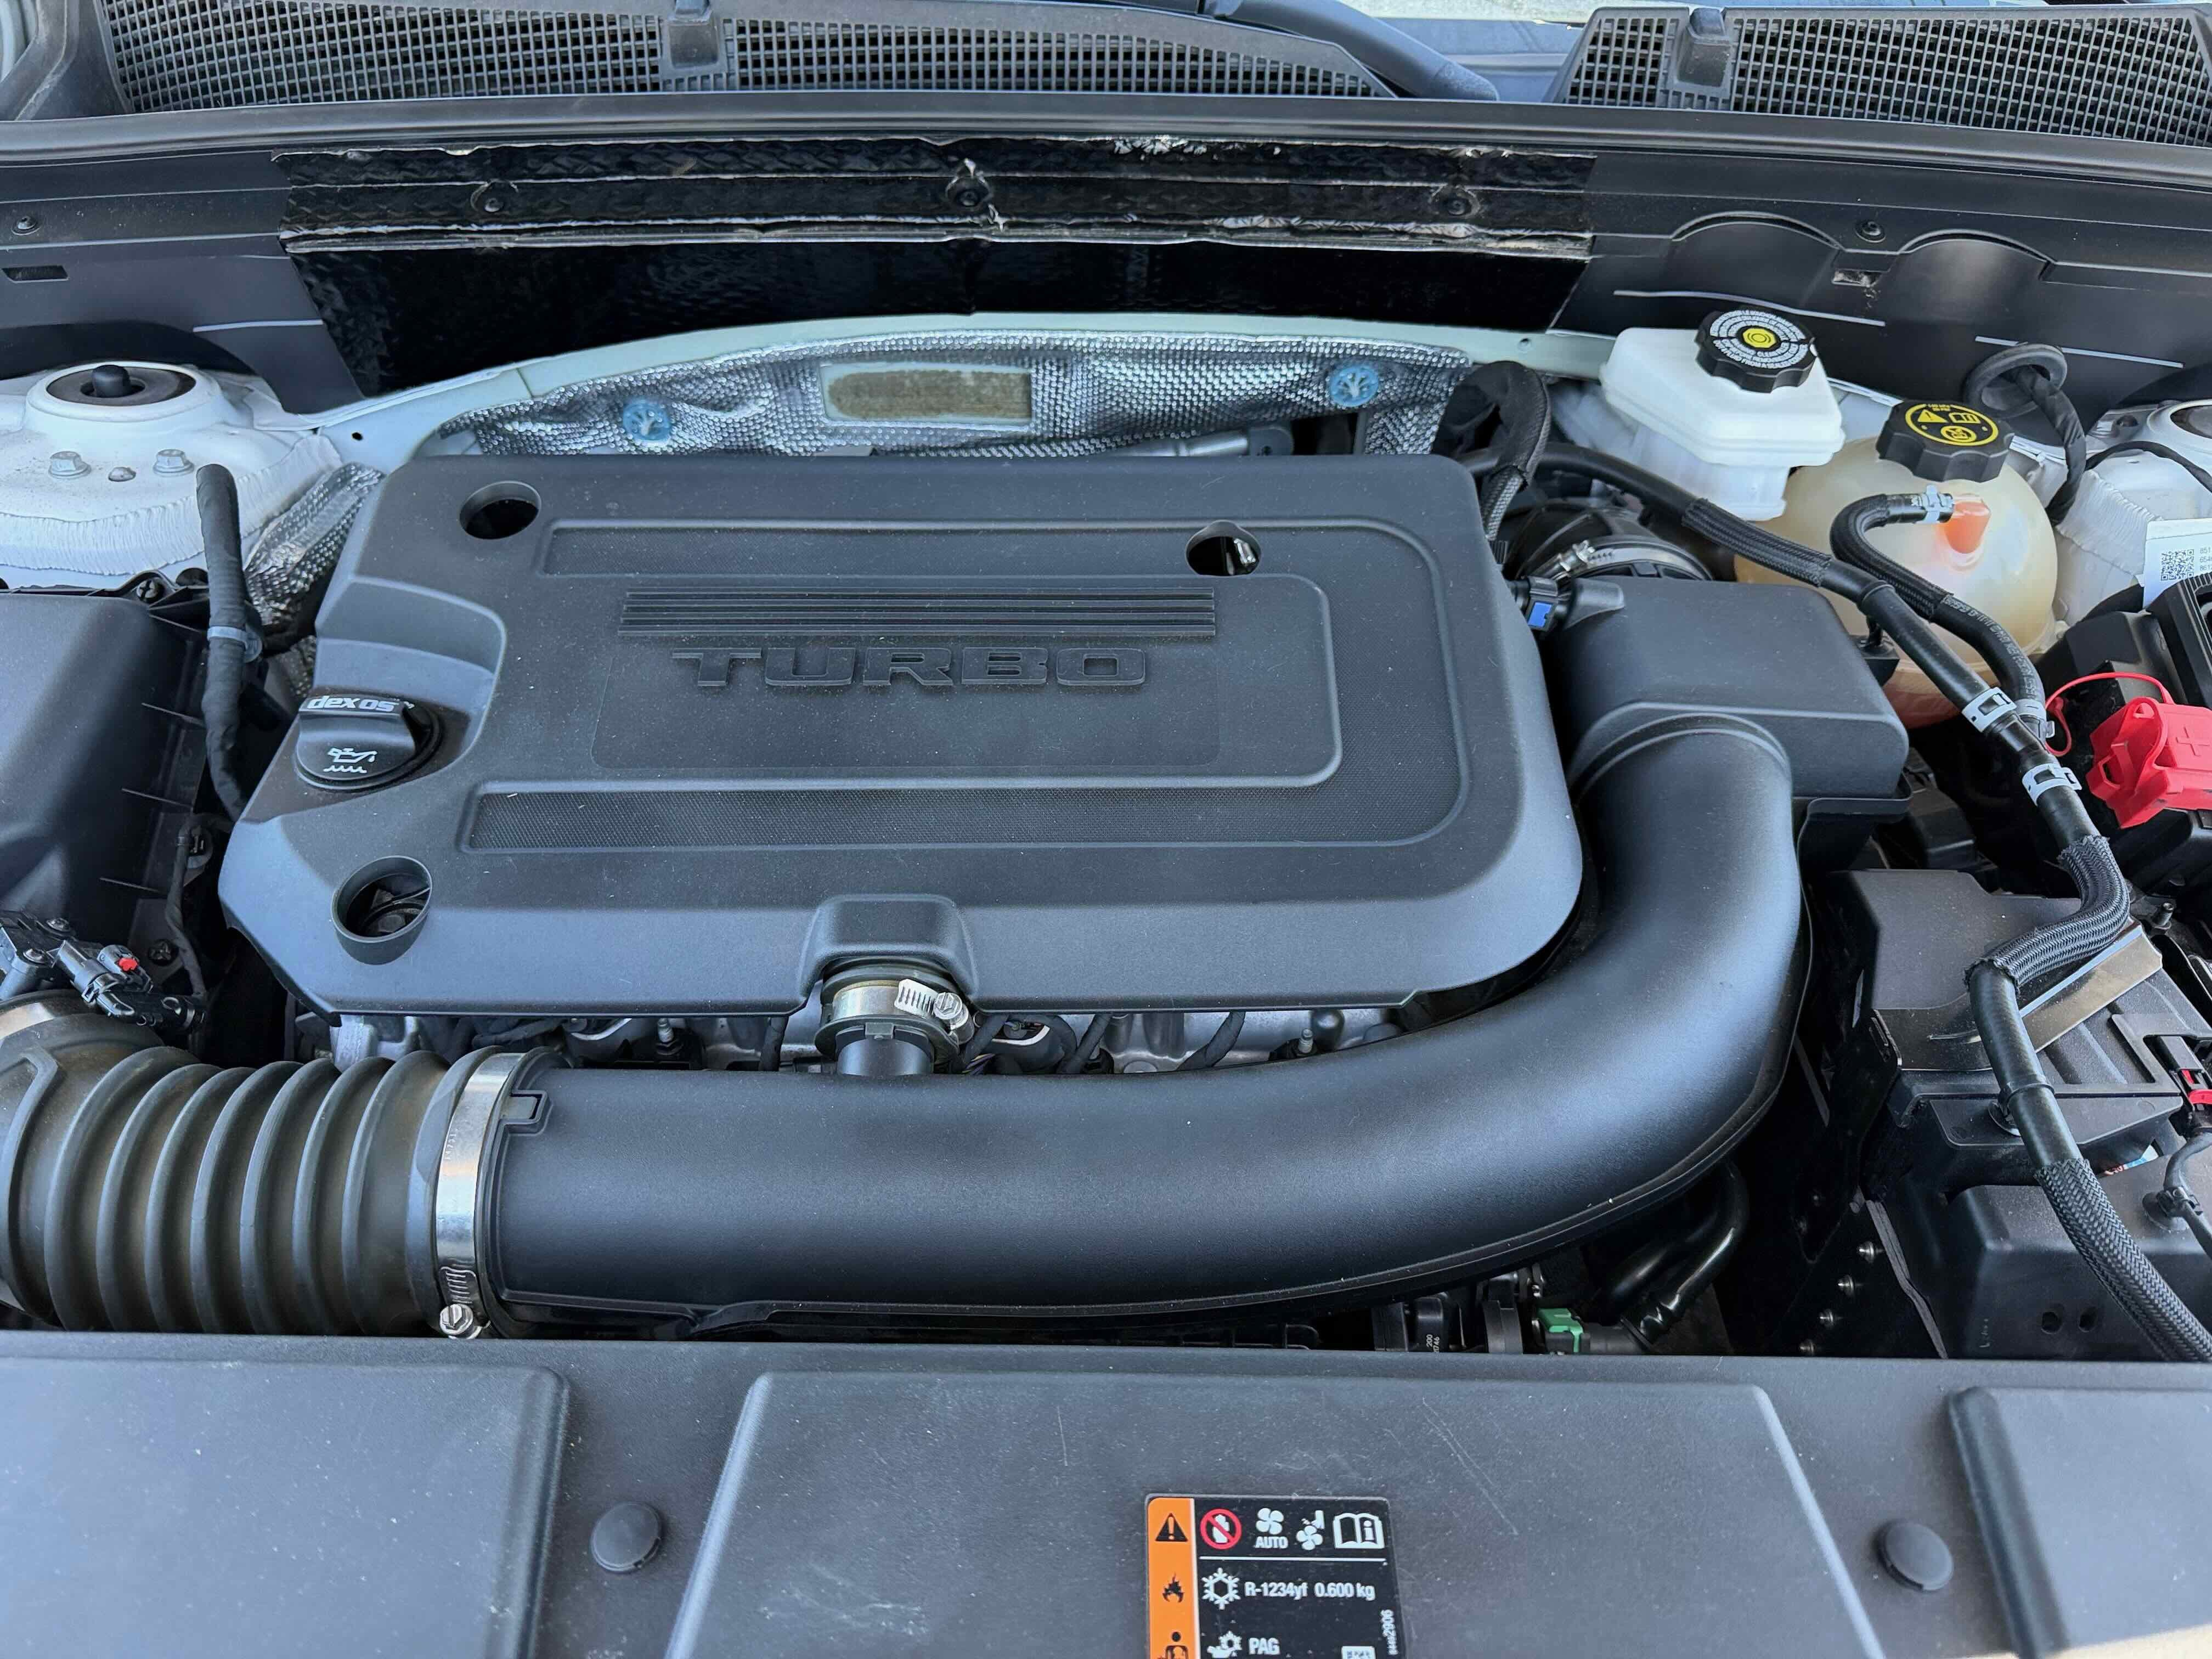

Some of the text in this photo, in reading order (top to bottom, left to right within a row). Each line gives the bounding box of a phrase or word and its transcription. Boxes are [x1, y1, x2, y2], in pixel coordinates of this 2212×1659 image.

[672, 647, 1147, 688] TURBO
[307, 695, 400, 712] dexos
[1255, 1536, 1288, 1549] AUTO
[1244, 1582, 1375, 1601] R-1234yf 0.600 kg
[1248, 1637, 1280, 1656] PAG
